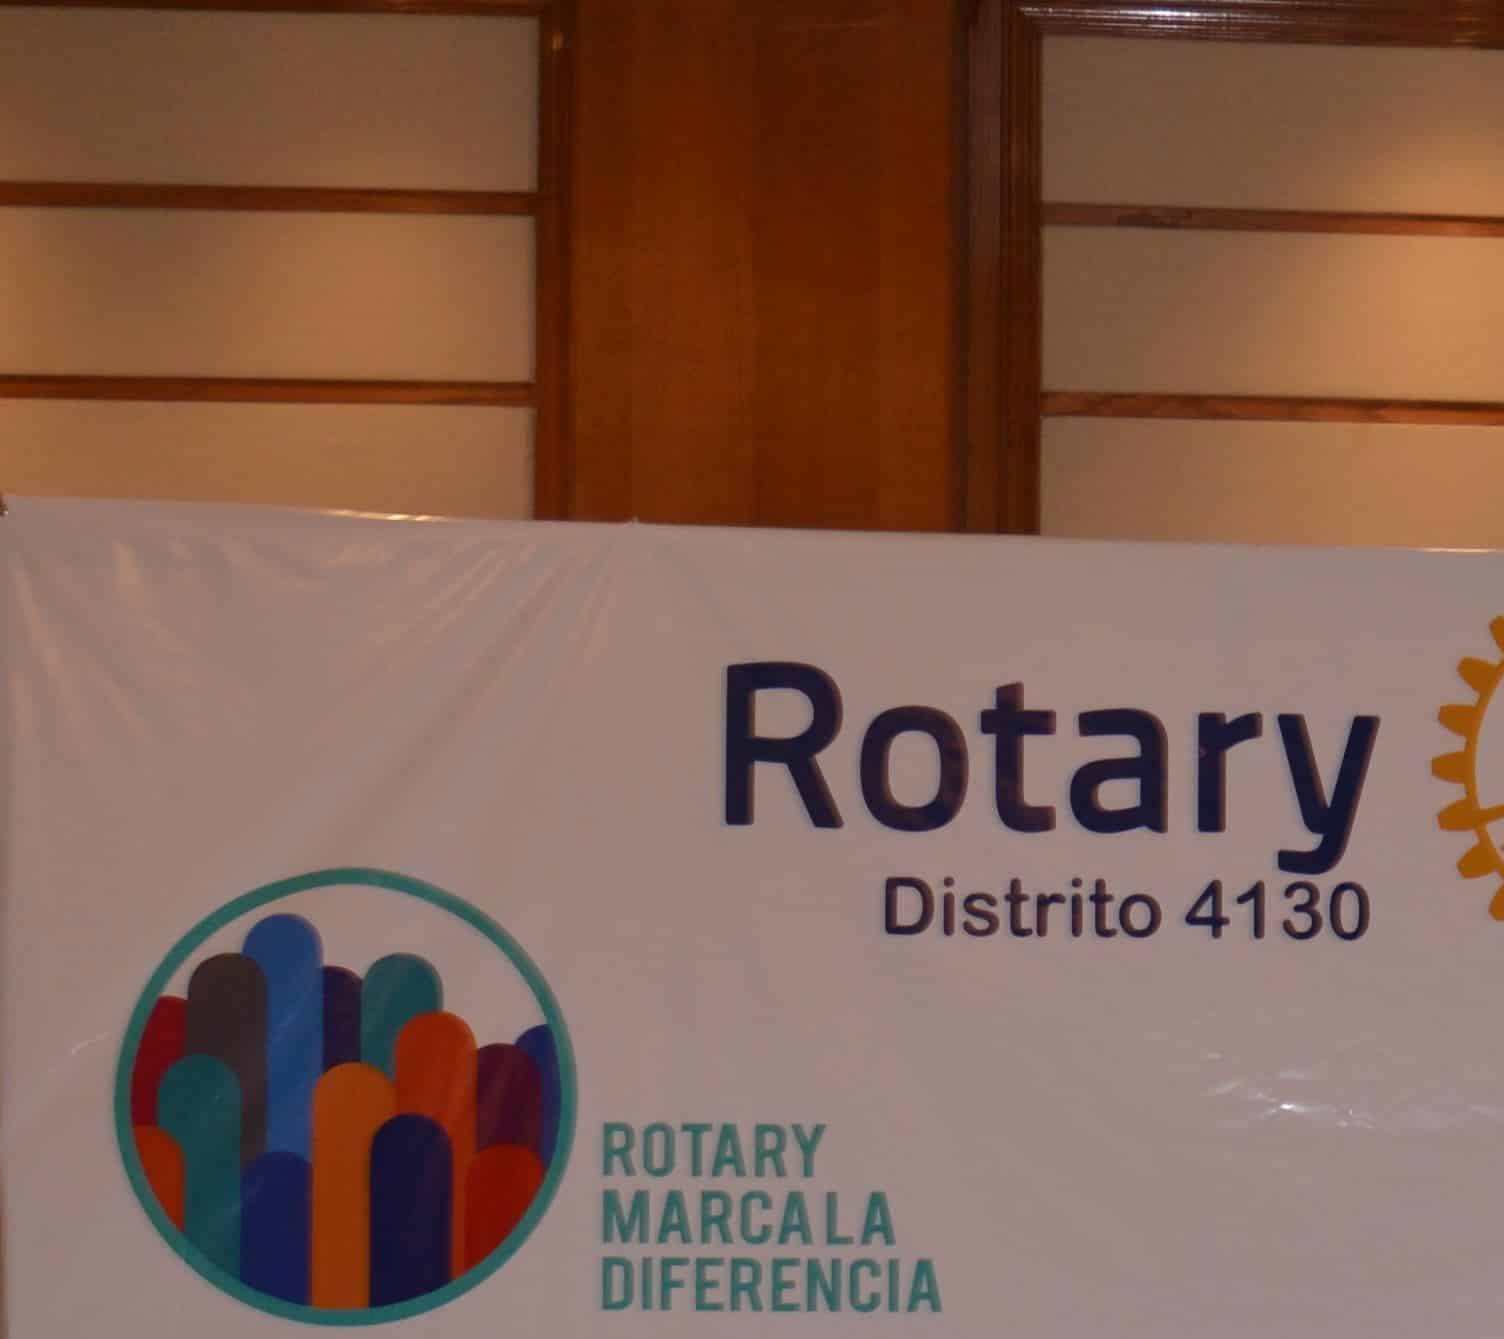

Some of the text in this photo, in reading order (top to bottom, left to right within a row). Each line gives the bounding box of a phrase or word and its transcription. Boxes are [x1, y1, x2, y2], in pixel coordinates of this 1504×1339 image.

[722, 661, 1381, 875] Rotary
[883, 876, 1372, 942] Distrito 4130
[602, 1122, 827, 1178] ROTARY
[601, 1256, 943, 1313] DIFERENCIA
